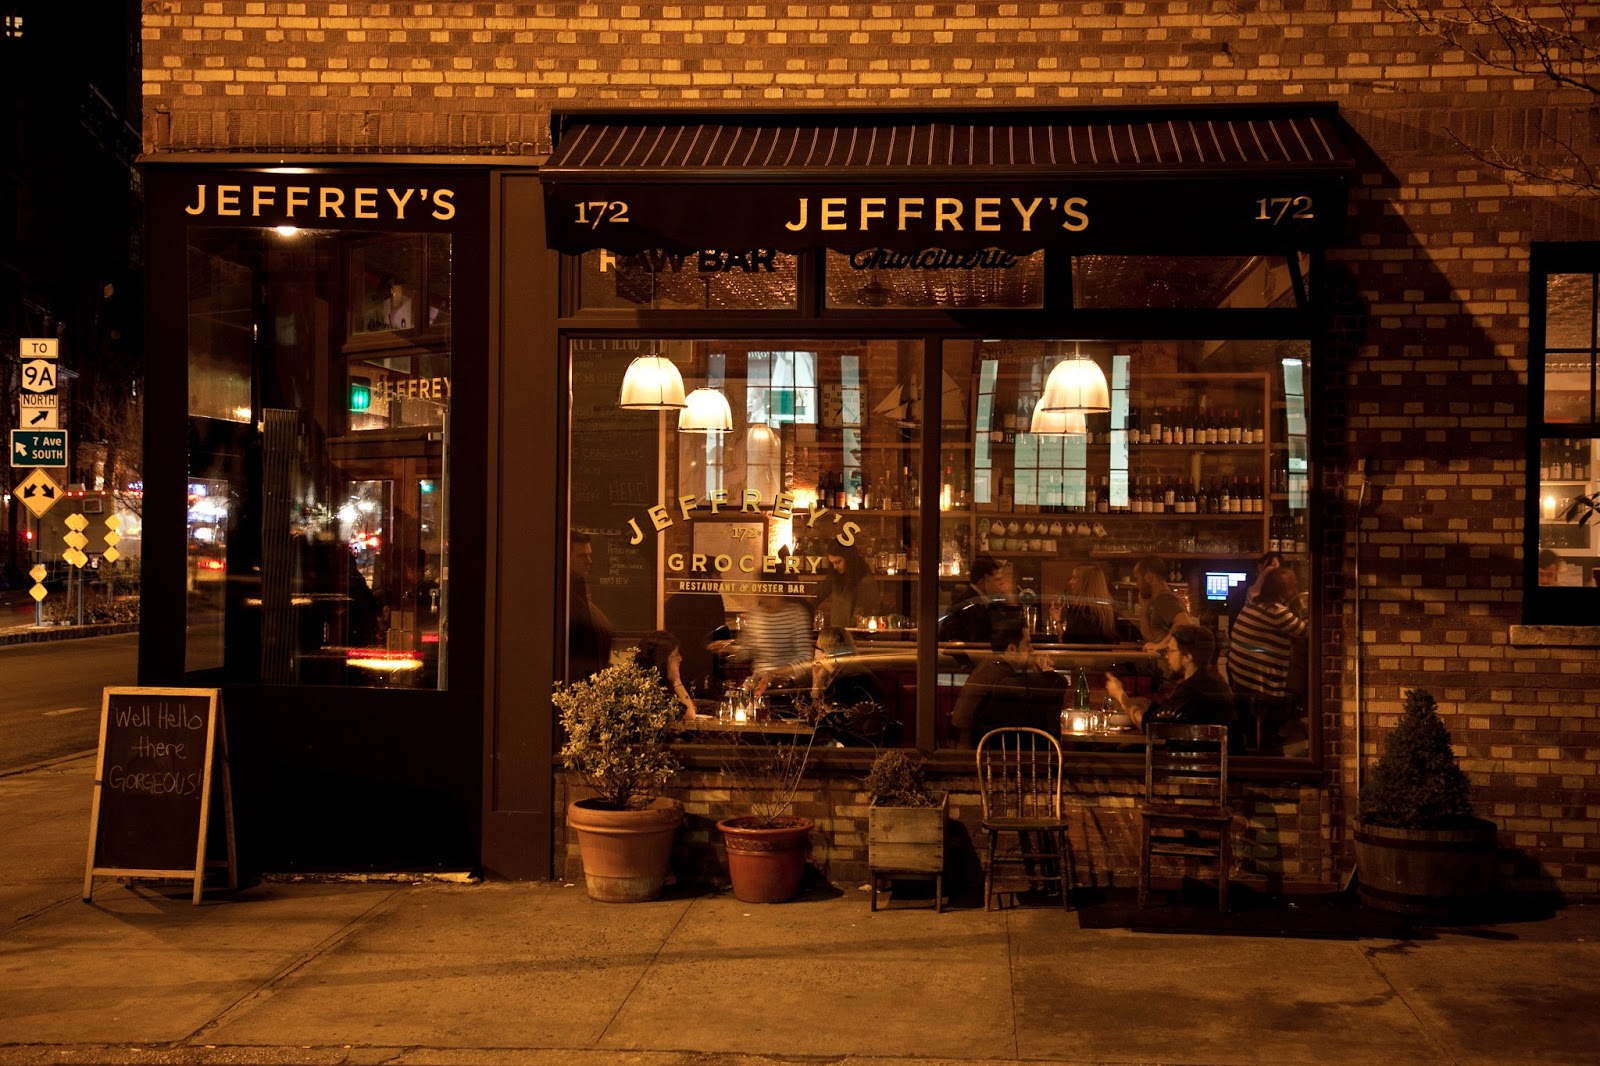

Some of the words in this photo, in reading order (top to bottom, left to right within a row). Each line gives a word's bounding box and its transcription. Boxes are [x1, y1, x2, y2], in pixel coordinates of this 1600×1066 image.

[185, 184, 456, 221] JEFFREY'S
[575, 200, 630, 230] 172
[784, 197, 1090, 233] JEFFREY'S
[1254, 195, 1314, 226] 172
[698, 248, 777, 273] BAR
[31, 343, 48, 353] TO
[24, 366, 54, 386] 9A
[23, 394, 55, 405] NORTH
[32, 436, 39, 446] 7
[43, 436, 62, 446] Ave
[32, 449, 63, 460] SOUTH
[627, 488, 862, 548] JEFFREY'S
[667, 553, 823, 575] GROCERY
[679, 581, 736, 593] RESTAURANT
[751, 582, 784, 594] OYSTER
[787, 584, 805, 594] BAR
[115, 705, 151, 728] Well
[158, 701, 203, 730] Hello
[131, 735, 187, 760] there
